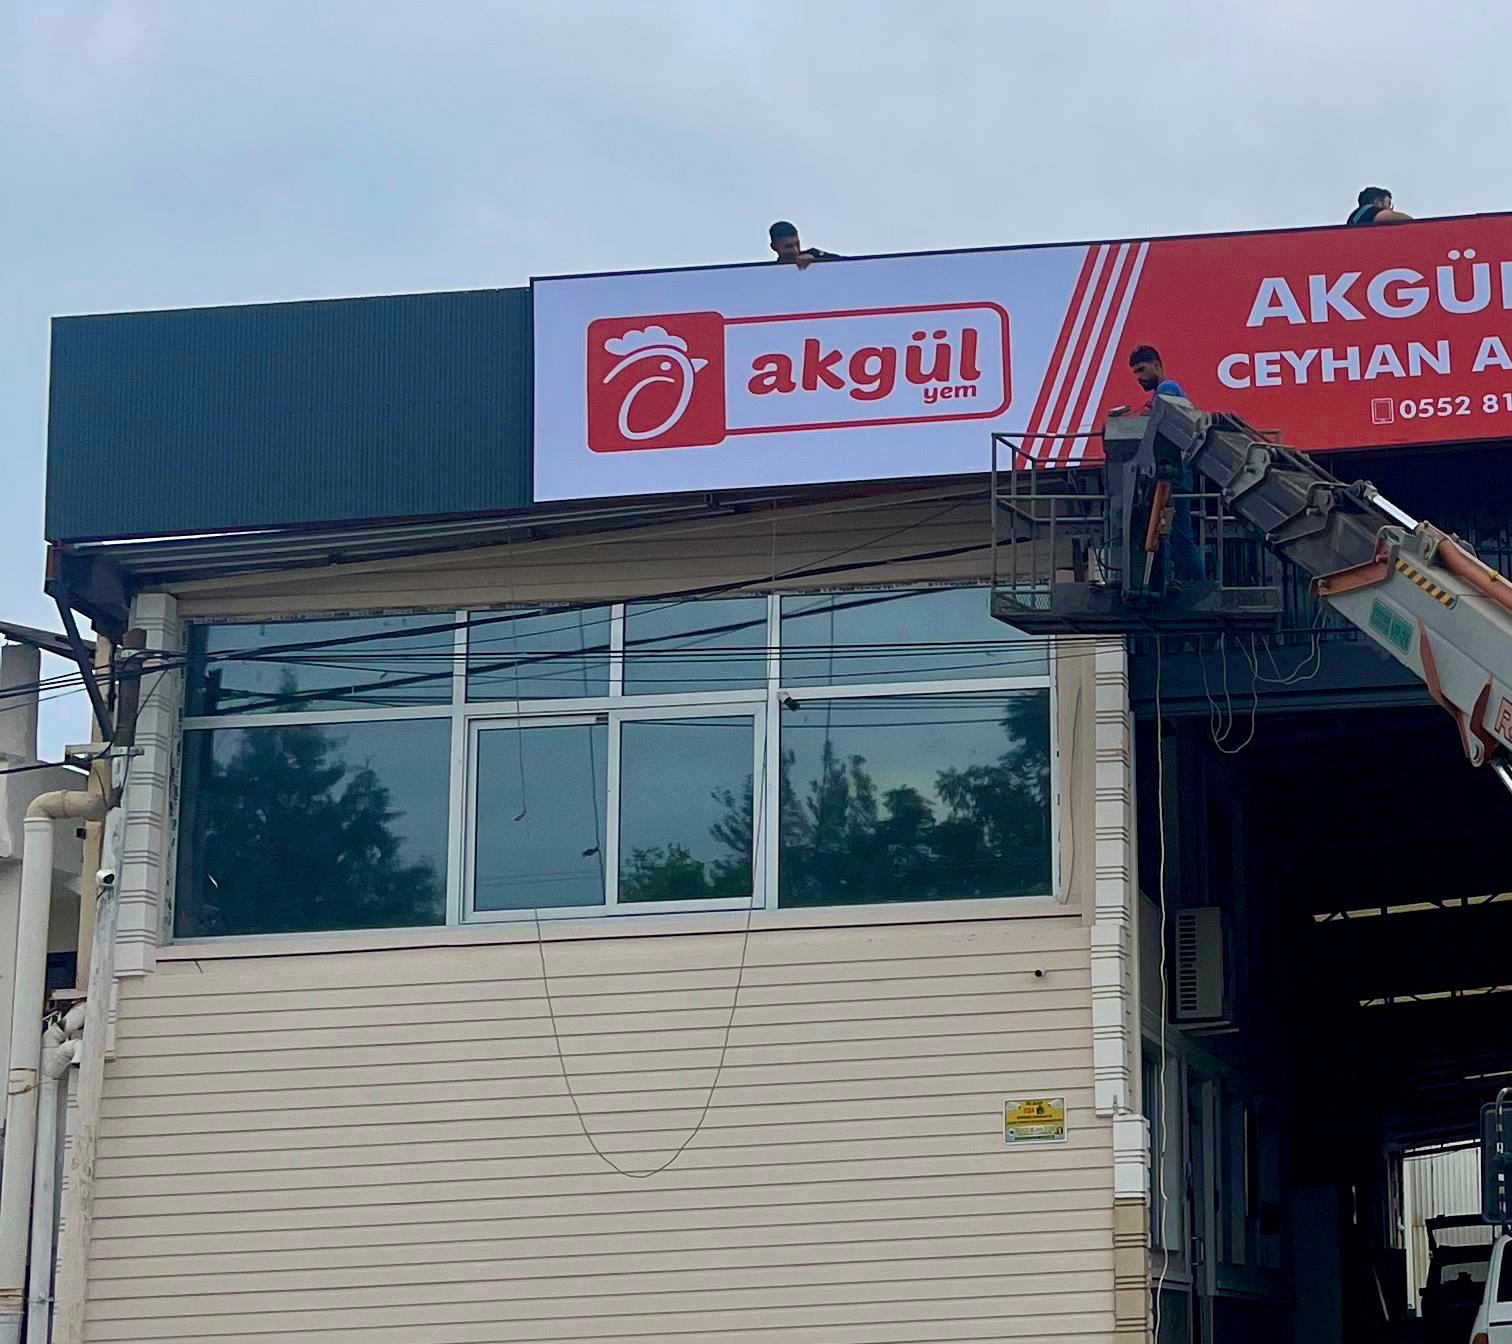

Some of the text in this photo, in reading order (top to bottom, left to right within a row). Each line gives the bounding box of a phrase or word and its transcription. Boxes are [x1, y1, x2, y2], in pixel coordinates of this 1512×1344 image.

[747, 328, 981, 402] akgül
[1217, 339, 1453, 389] CEYHAN
[923, 383, 977, 404] yem
[1399, 396, 1472, 420] 0552
